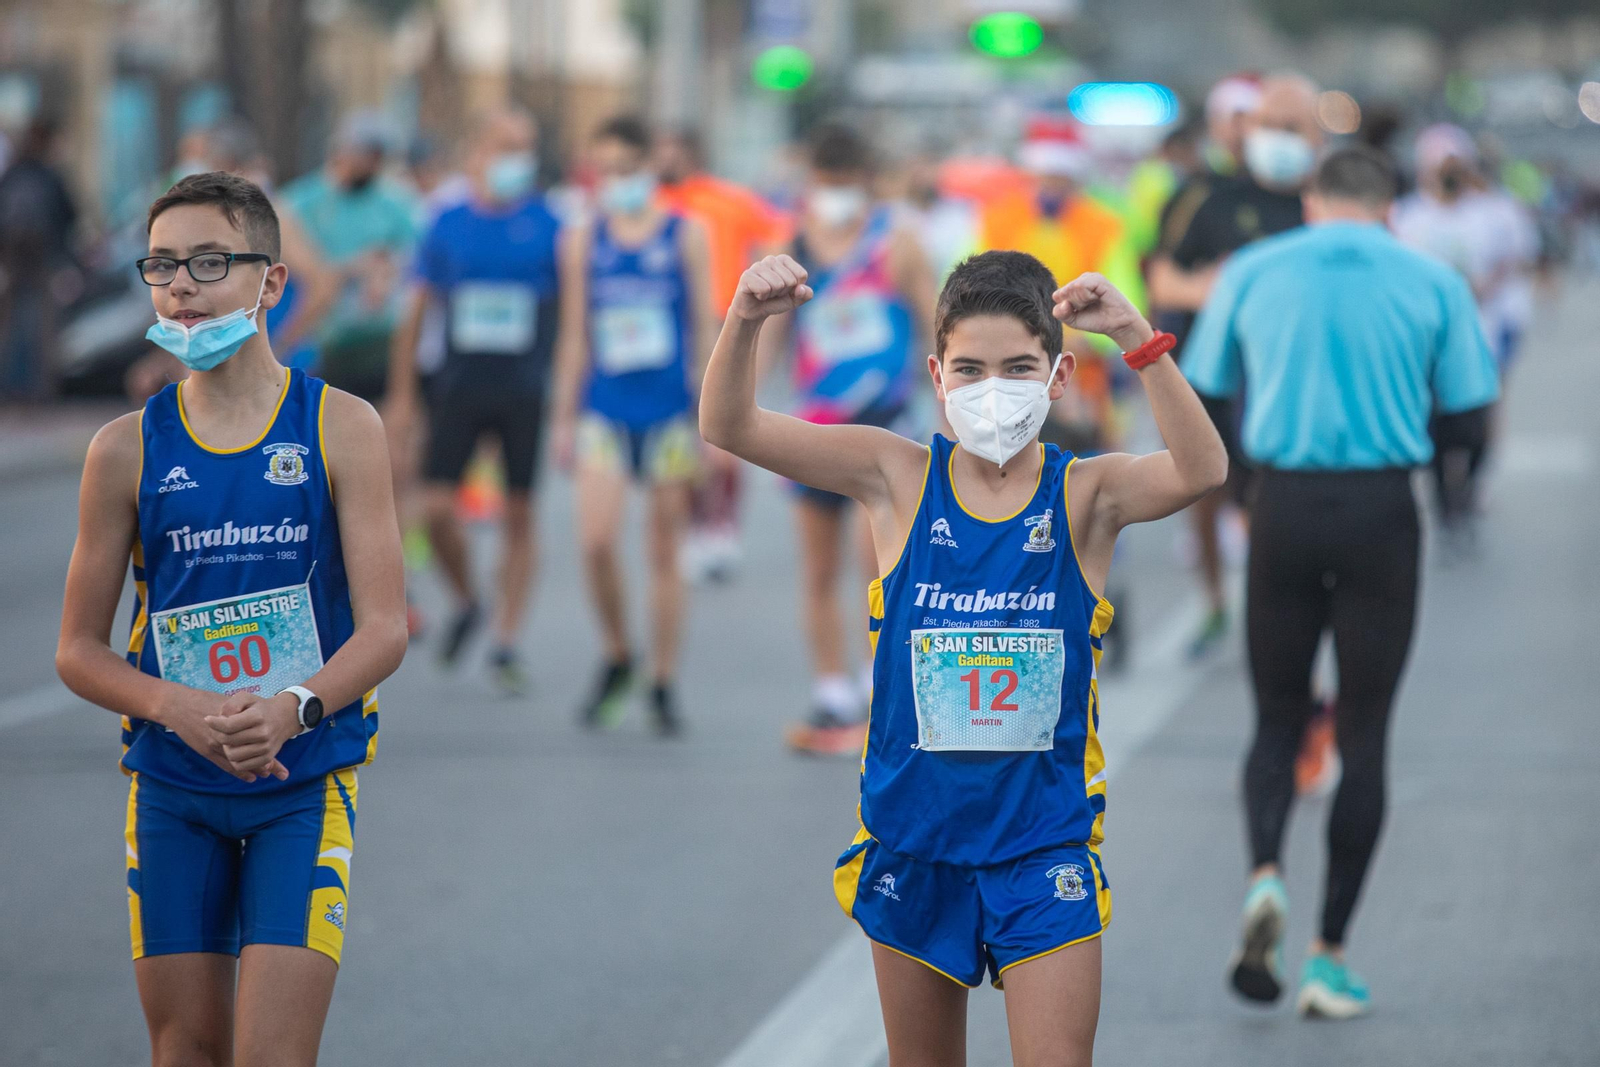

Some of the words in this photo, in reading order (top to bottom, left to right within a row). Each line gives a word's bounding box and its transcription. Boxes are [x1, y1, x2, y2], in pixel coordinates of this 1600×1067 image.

[166, 517, 309, 553] Tirabuzón
[930, 537, 959, 548] stral
[195, 555, 225, 566] Piedra
[225, 553, 264, 563] Pikachos
[275, 551, 298, 561] 1982
[913, 582, 1056, 613] Tirabuzón
[166, 617, 178, 634] V
[181, 611, 212, 632] SAN
[214, 593, 301, 624] SILVESTRE
[203, 622, 260, 641] Gaditana
[942, 618, 971, 629] Piedra
[972, 618, 1009, 629] Pikachos
[1018, 618, 1040, 628] 1982
[921, 637, 931, 653] V
[934, 636, 968, 653] SAN
[972, 636, 1056, 653] SILVESTRE
[208, 635, 271, 684] 60
[957, 654, 1014, 667] Gaditana
[959, 668, 1019, 711] 12
[971, 718, 1003, 726] MARTIN
